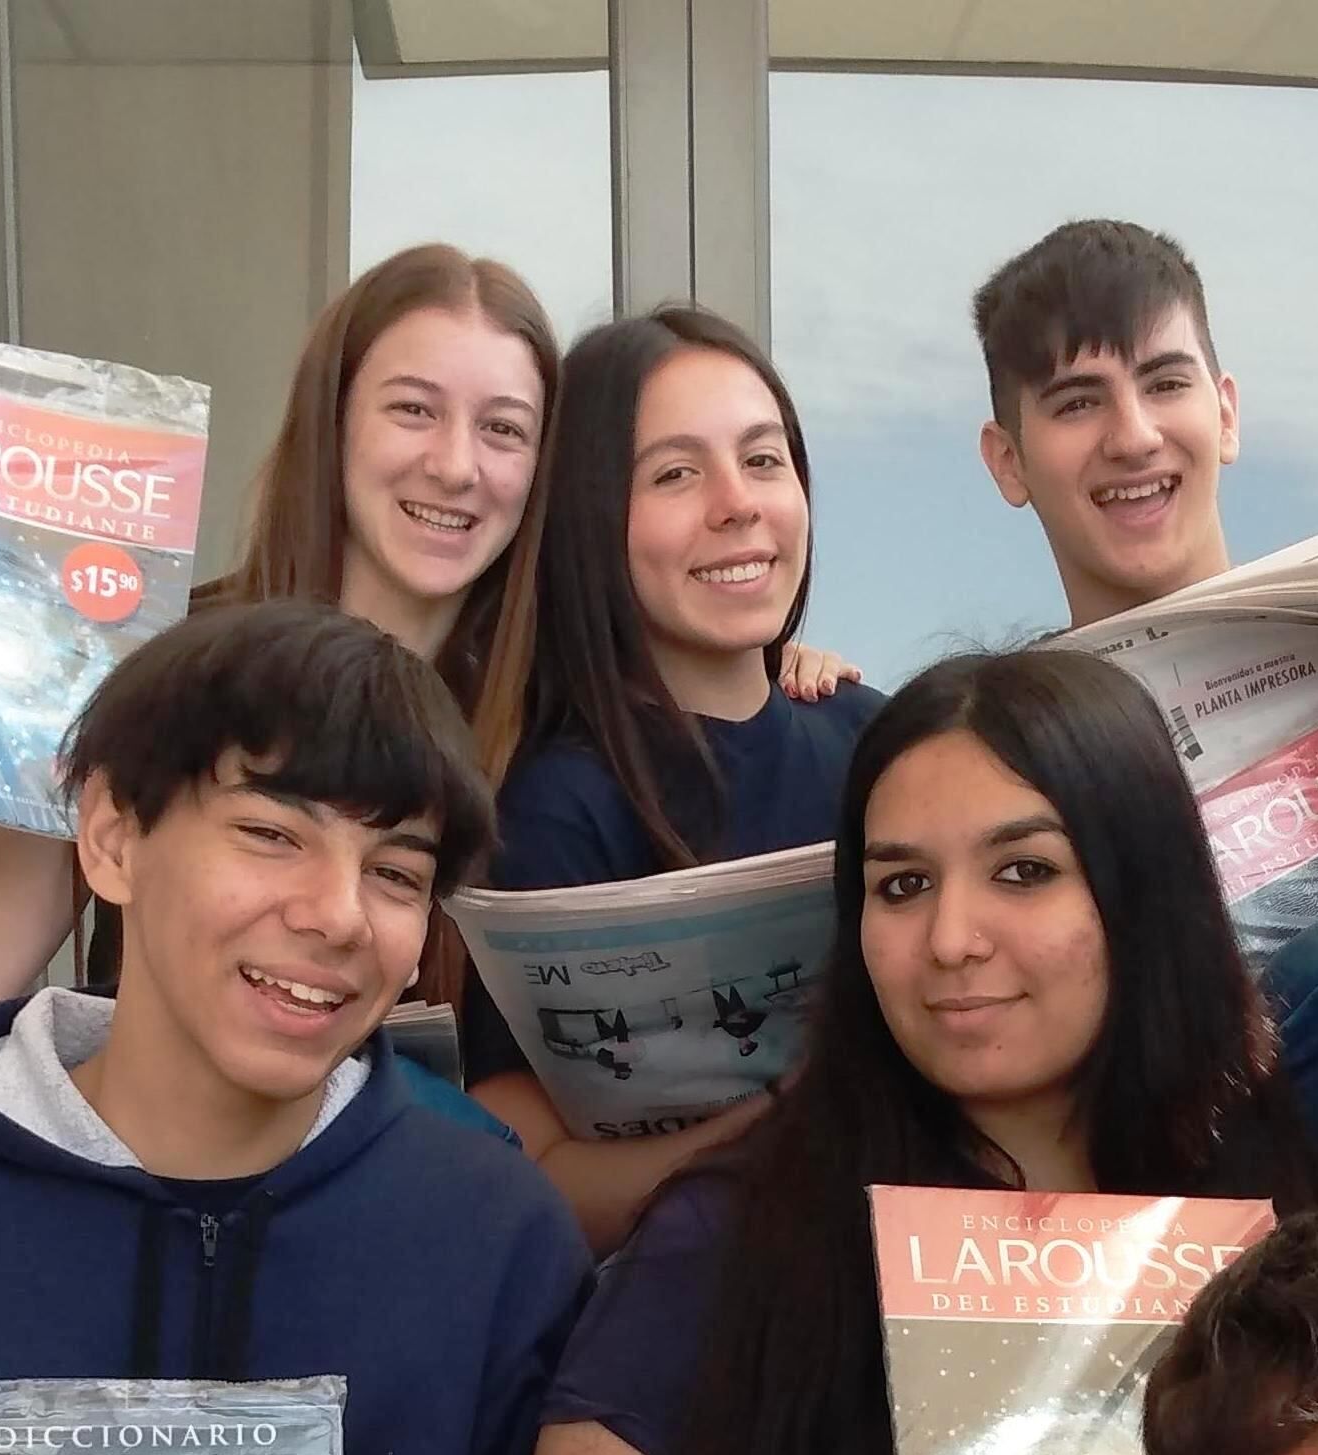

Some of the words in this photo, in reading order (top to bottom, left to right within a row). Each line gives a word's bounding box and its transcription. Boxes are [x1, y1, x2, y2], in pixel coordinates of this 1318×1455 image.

[1193, 689, 1244, 719] PLANTA
[1245, 661, 1317, 699] IMPRESORA
[1204, 667, 1254, 691] Bienvenidos
[962, 1214, 1188, 1237] ENCICLOPEA
[931, 1293, 995, 1313] DEL
[1015, 1294, 1191, 1315] ESTUDIAN
